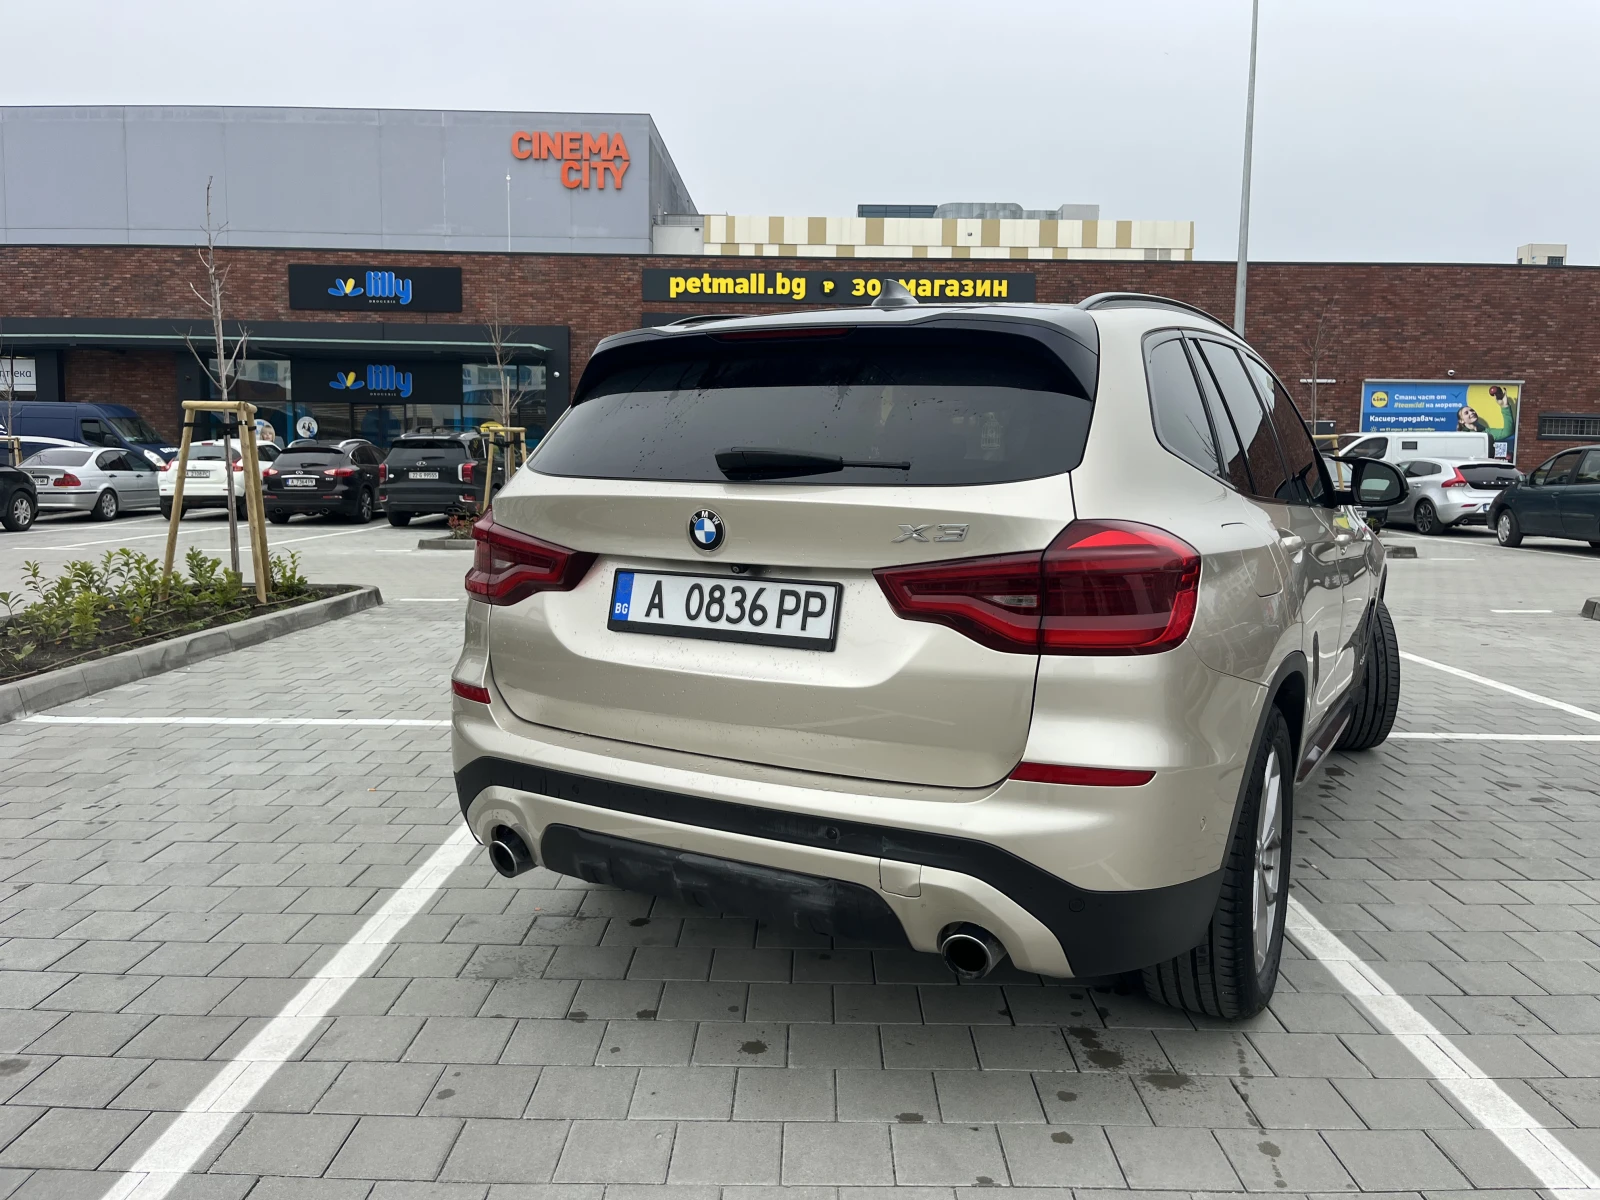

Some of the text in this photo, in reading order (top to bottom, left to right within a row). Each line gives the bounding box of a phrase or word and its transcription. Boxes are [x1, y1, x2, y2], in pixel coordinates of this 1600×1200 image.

[511, 131, 630, 160] CINEMA
[561, 160, 631, 189] CITY
[366, 271, 412, 305] lilly
[669, 272, 806, 300] petmall.bg
[851, 278, 1008, 298] зомагазин
[367, 364, 412, 398] lilly
[1369, 415, 1433, 423] Касиер-продавач
[691, 510, 720, 525] BMW
[890, 523, 970, 542] X3
[615, 603, 628, 615] BG
[644, 580, 827, 631] A 0836 PP
